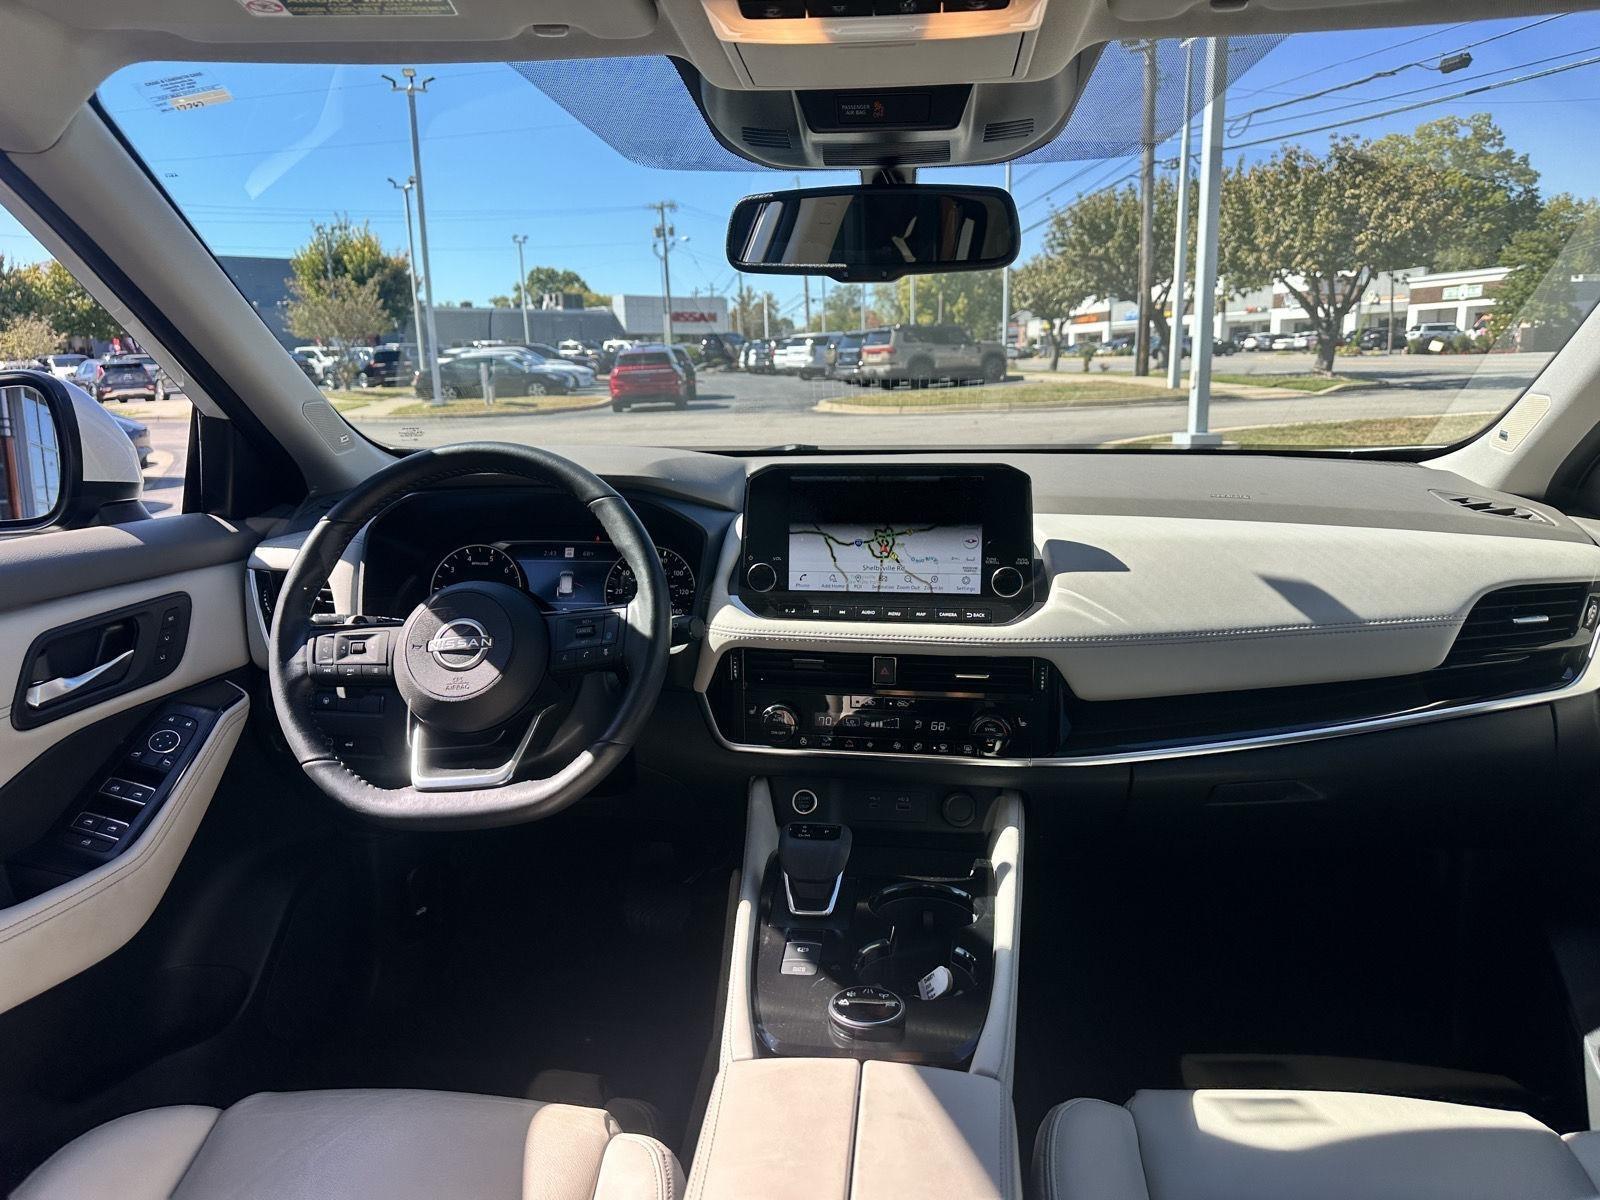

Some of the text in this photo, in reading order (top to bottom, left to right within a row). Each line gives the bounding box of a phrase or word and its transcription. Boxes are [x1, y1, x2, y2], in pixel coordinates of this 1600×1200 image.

[429, 638, 492, 650] NISSAN
[818, 716, 832, 726] 70
[930, 721, 946, 731] 68
